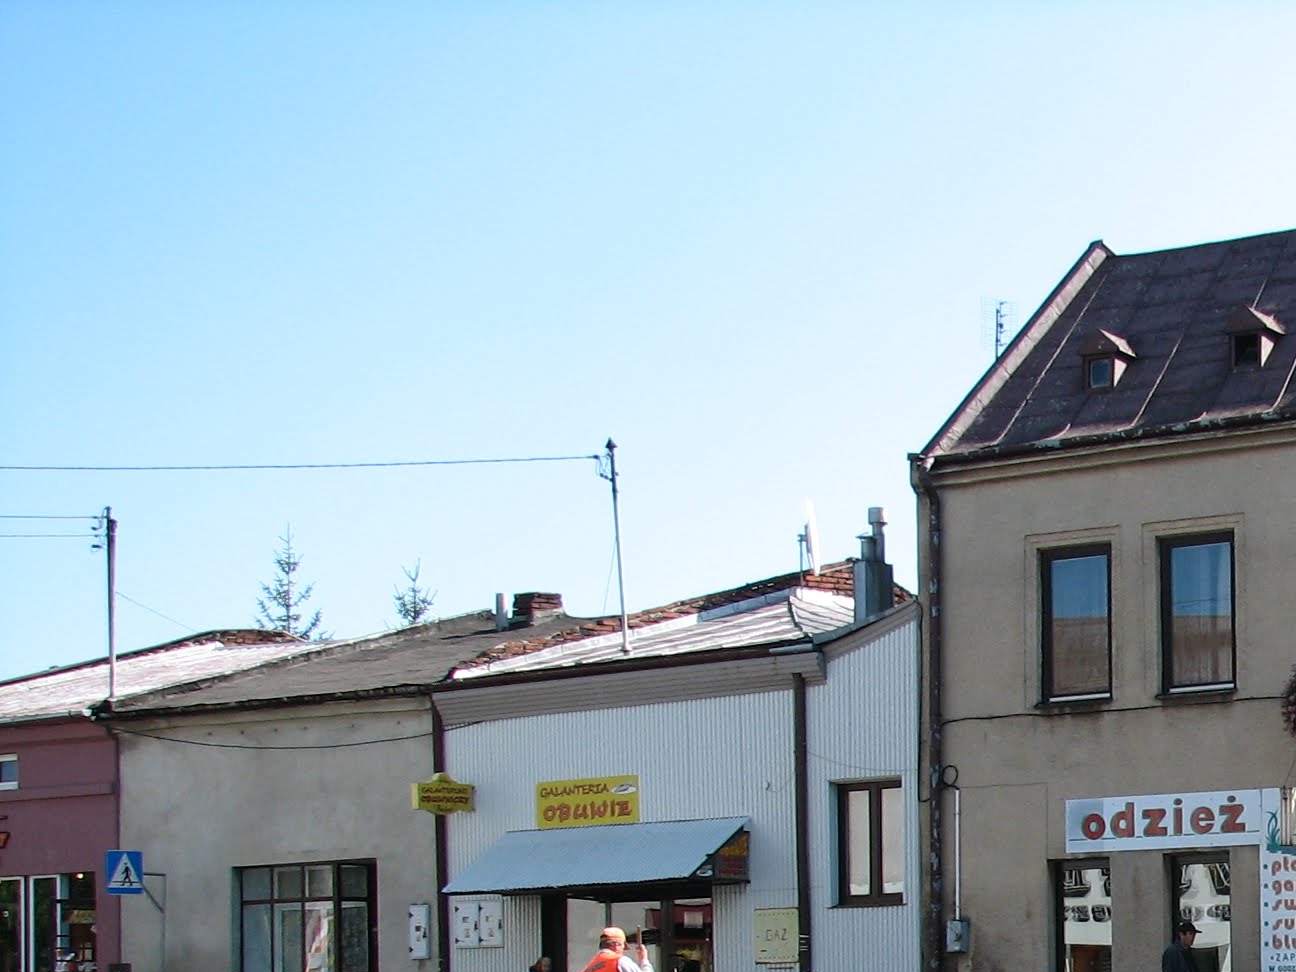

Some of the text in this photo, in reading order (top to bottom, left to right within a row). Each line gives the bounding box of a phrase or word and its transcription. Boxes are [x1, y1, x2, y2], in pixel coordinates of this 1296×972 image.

[540, 783, 609, 799] GALANTERIA
[543, 799, 632, 822] OBUWIE
[1081, 795, 1246, 840] odzież
[765, 928, 787, 942] GAZ
